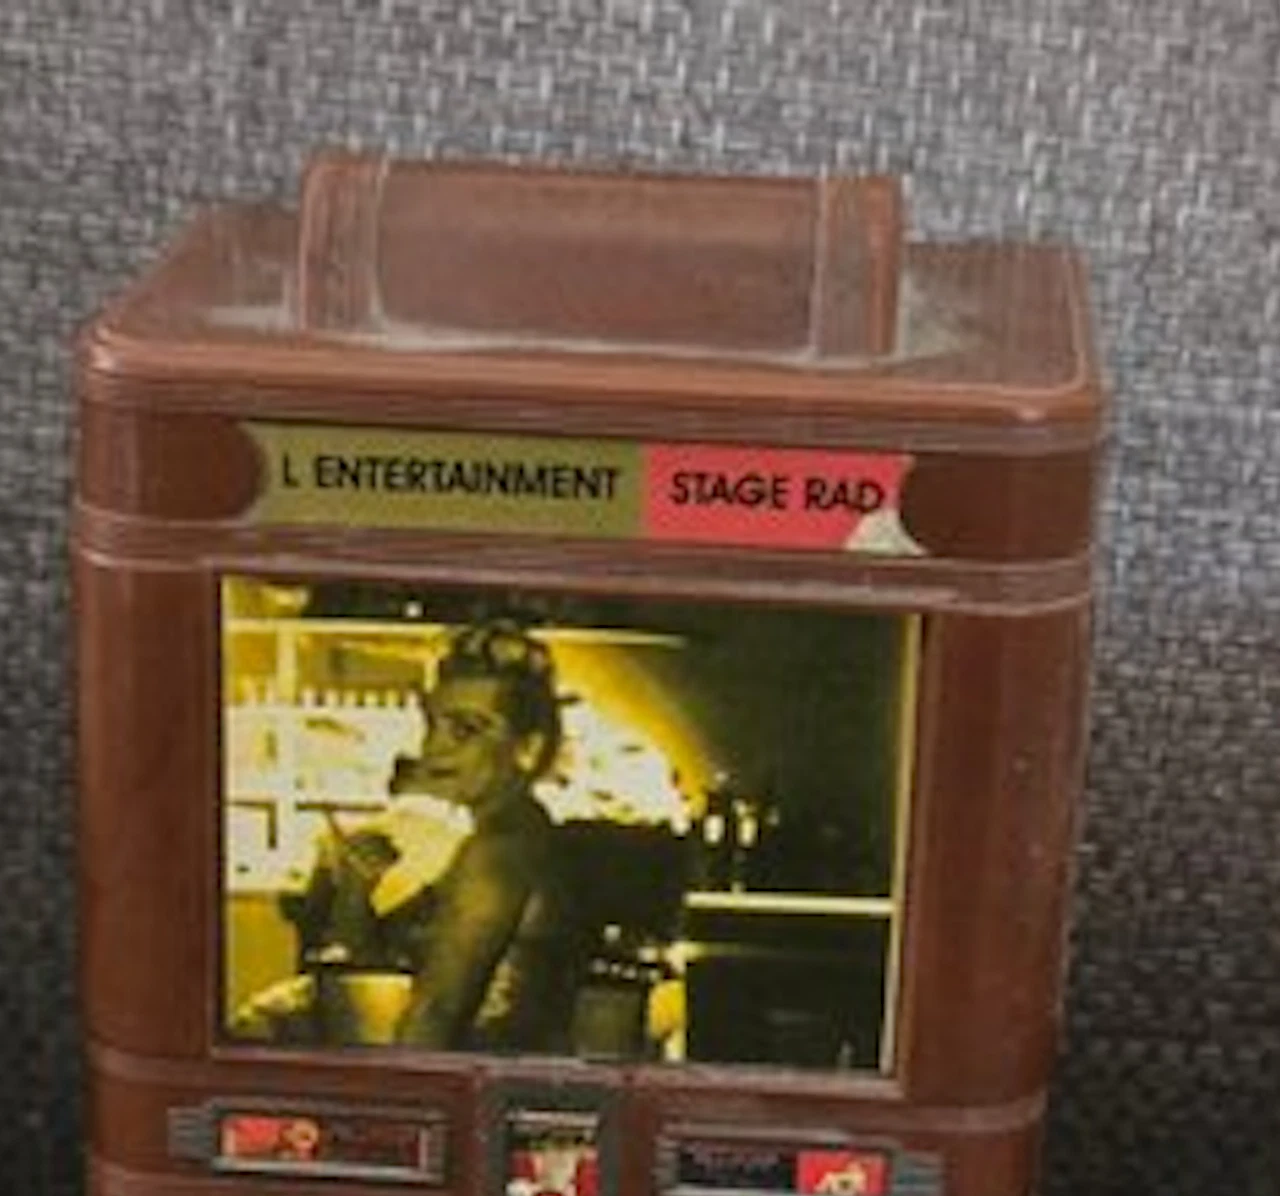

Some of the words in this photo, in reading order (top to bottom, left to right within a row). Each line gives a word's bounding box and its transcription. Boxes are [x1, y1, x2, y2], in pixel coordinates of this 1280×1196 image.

[282, 452, 301, 489] L
[315, 454, 621, 502] ENTERTAINMENT
[670, 471, 790, 511] STAGE
[804, 476, 886, 514] RAD
